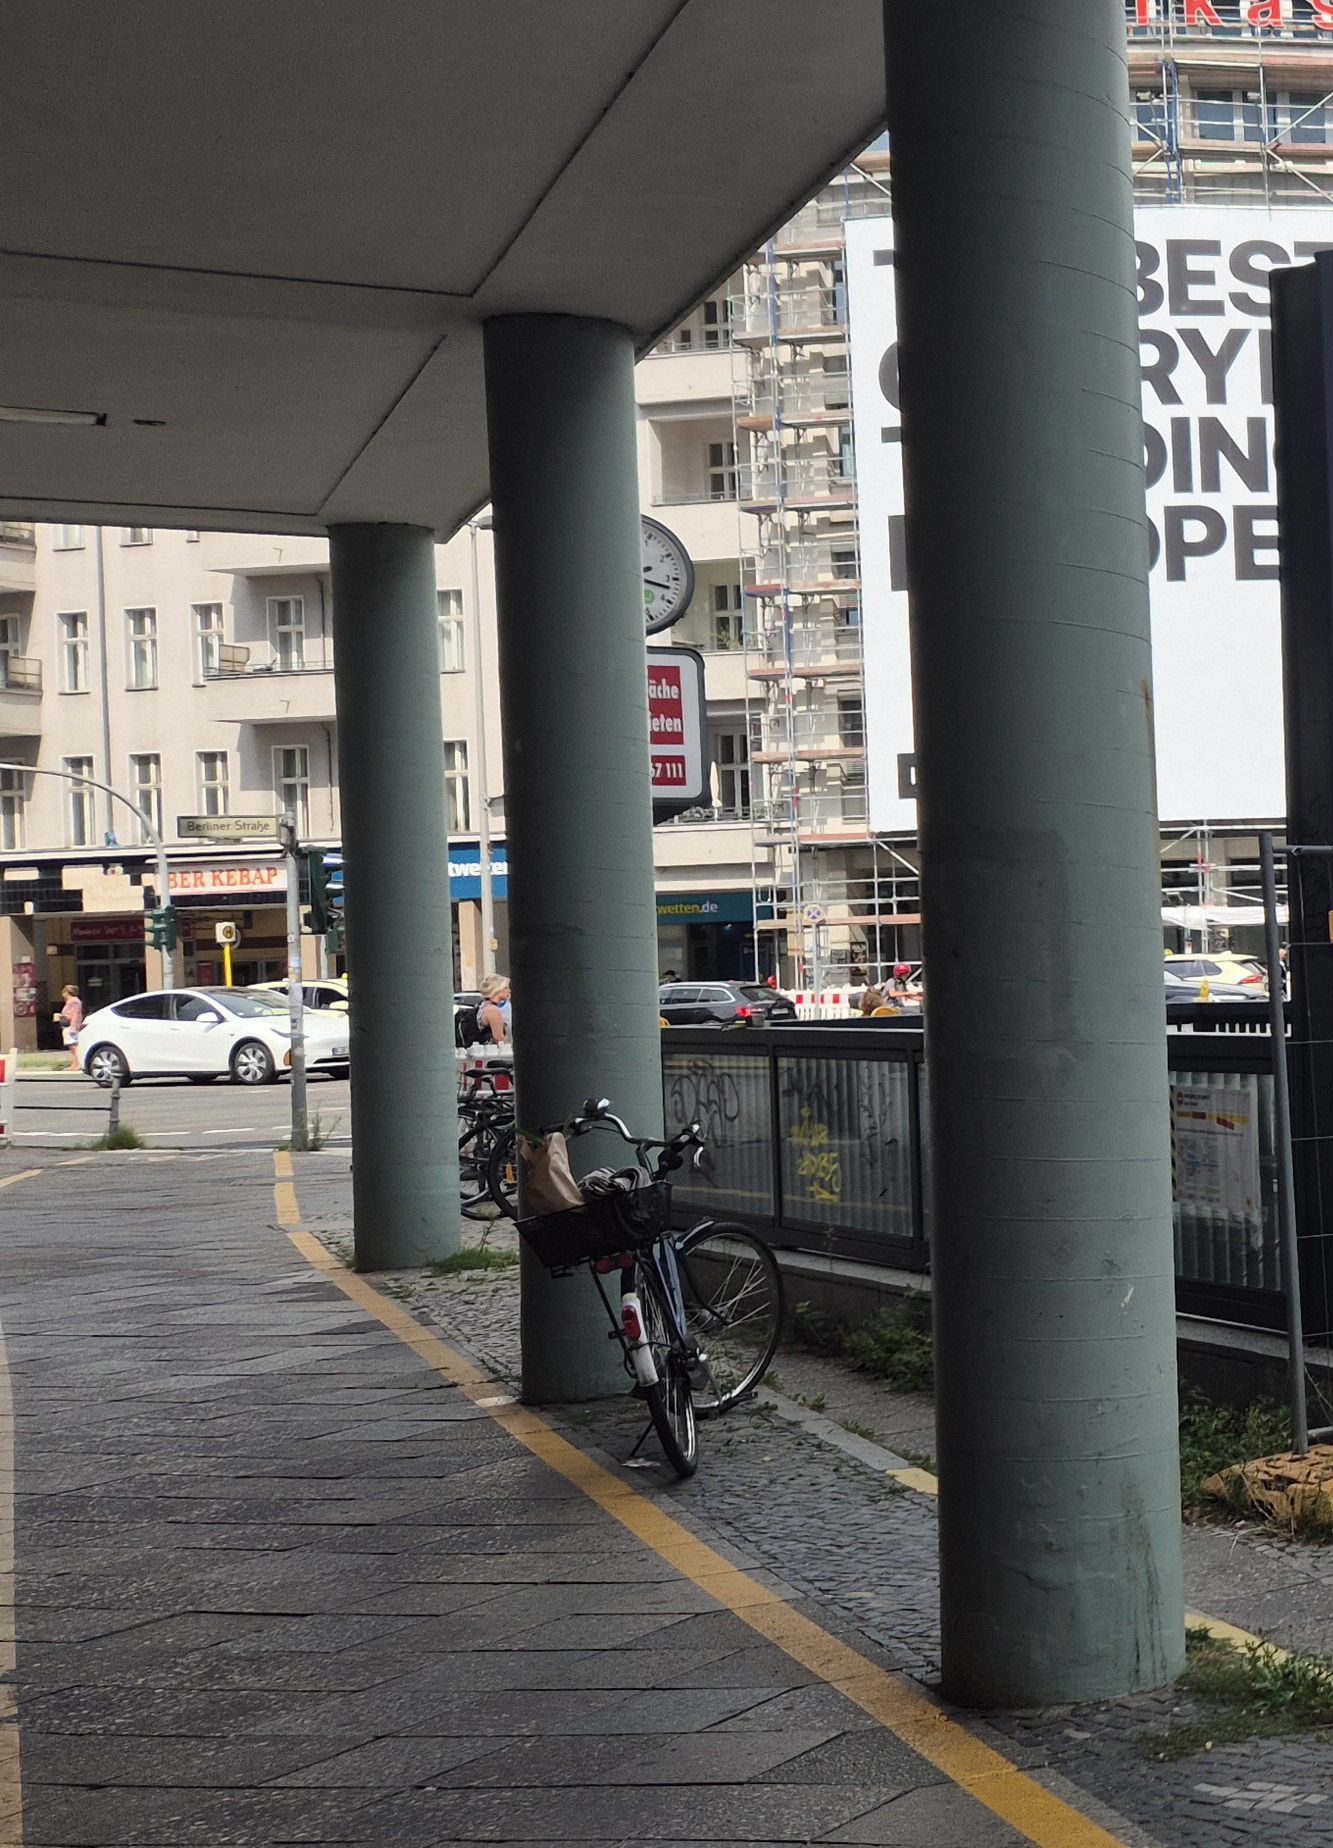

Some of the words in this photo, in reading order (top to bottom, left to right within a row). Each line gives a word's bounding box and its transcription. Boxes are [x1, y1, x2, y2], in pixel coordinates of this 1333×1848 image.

[648, 677, 680, 700] äche
[666, 762, 683, 778] 111
[187, 820, 230, 832] Berliner
[234, 820, 271, 833] Straße
[210, 866, 278, 887] KEBAP
[656, 901, 719, 914] wetten.de
